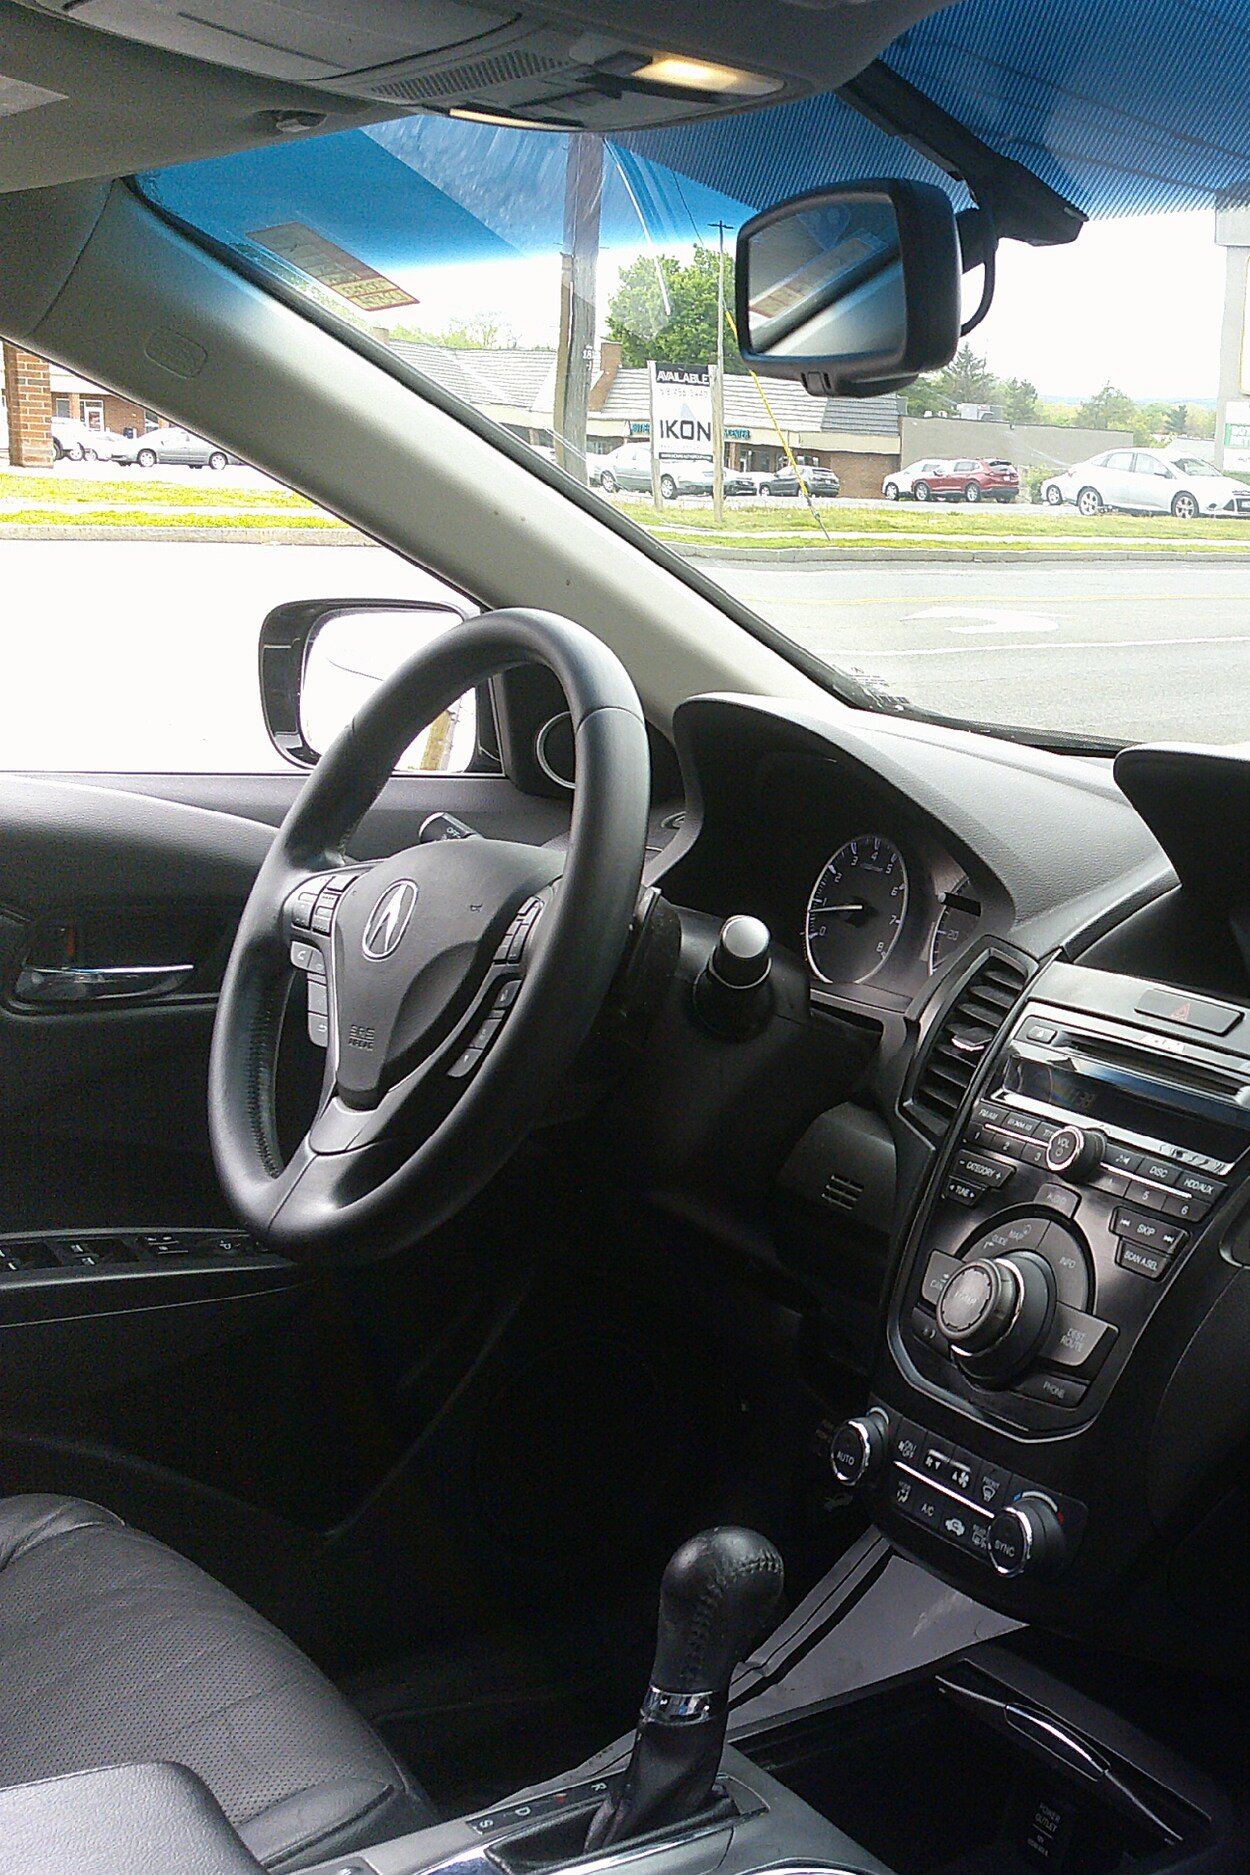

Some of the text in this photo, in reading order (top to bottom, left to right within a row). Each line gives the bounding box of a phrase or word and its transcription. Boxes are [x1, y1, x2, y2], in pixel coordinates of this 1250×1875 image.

[657, 371, 710, 384] AVAILABLE
[660, 420, 711, 441] IKON
[851, 855, 859, 865] 3
[871, 851, 878, 861] 4
[885, 864, 893, 874] 5
[834, 872, 842, 882] 2
[890, 887, 898, 896] 6
[889, 915, 897, 924] 7
[819, 926, 827, 936] 0
[946, 929, 960, 941] 20
[876, 942, 884, 951] 8
[1002, 1142, 1010, 1151] 2
[1057, 1137, 1070, 1149] VOL
[1034, 1152, 1042, 1161] 3
[966, 1160, 995, 1177] CATEGORY
[1149, 1165, 1169, 1178] DISC
[955, 1185, 970, 1197] TUNE
[1183, 1178, 1214, 1195] HDD/AUX
[1142, 1190, 1150, 1200] 5
[1181, 1205, 1189, 1215] 6
[1136, 1222, 1156, 1236] SKIP
[1060, 1335, 1085, 1352] ROUTE
[1043, 1381, 1066, 1399] PHONE
[836, 1450, 855, 1466] AUTO
[921, 1502, 935, 1517] A/C
[994, 1539, 1015, 1558] SYNC
[514, 1806, 531, 1816] D
[479, 1819, 494, 1829] S
